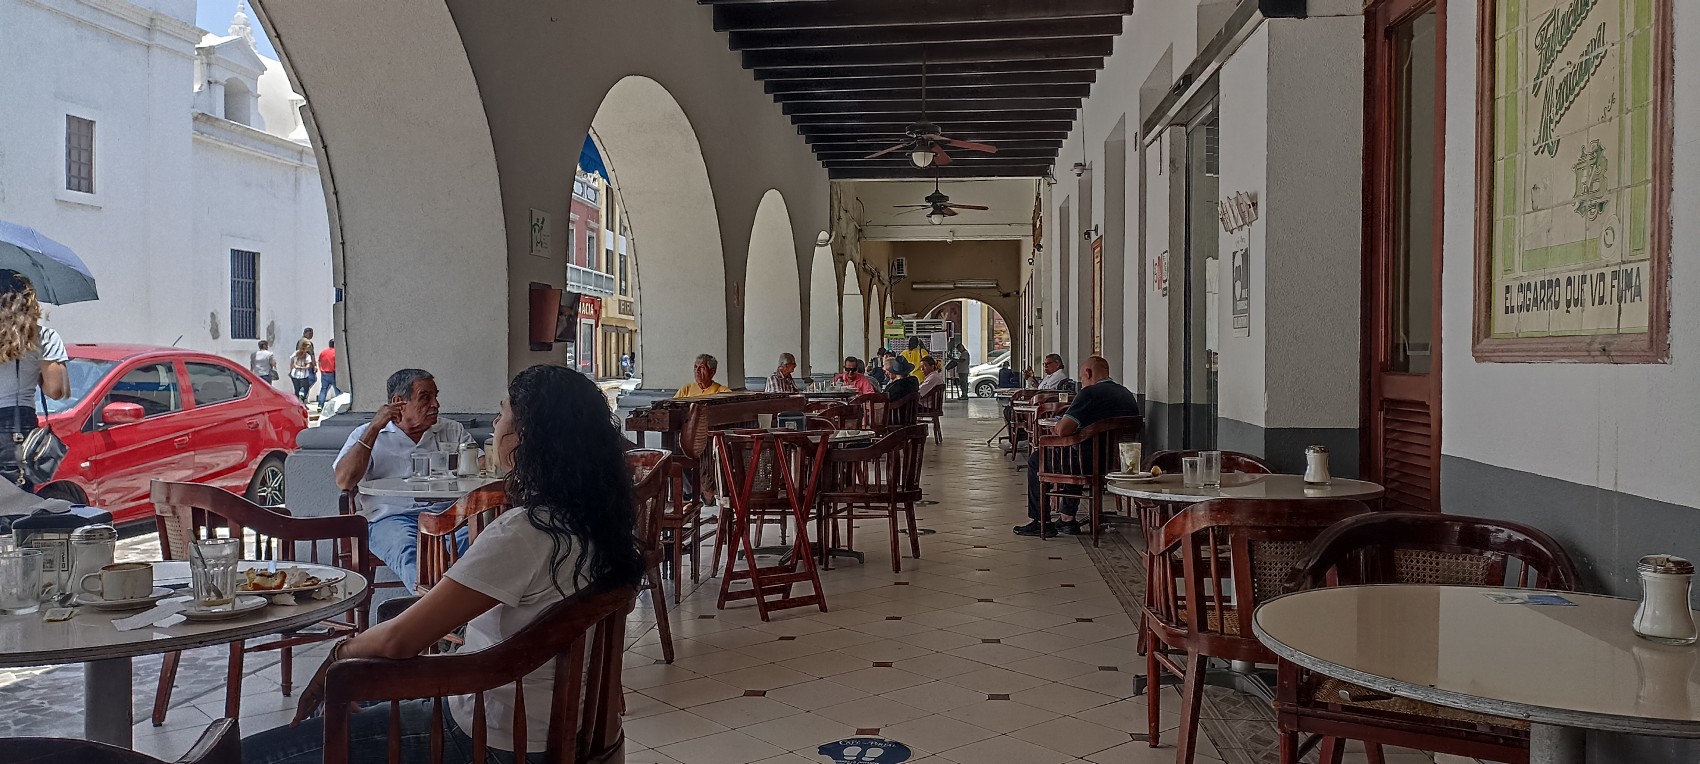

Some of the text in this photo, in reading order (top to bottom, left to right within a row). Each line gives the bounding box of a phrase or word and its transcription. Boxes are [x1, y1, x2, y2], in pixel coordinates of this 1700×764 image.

[1505, 266, 1642, 314] EL CIGARRO QUE VD. FUMA
